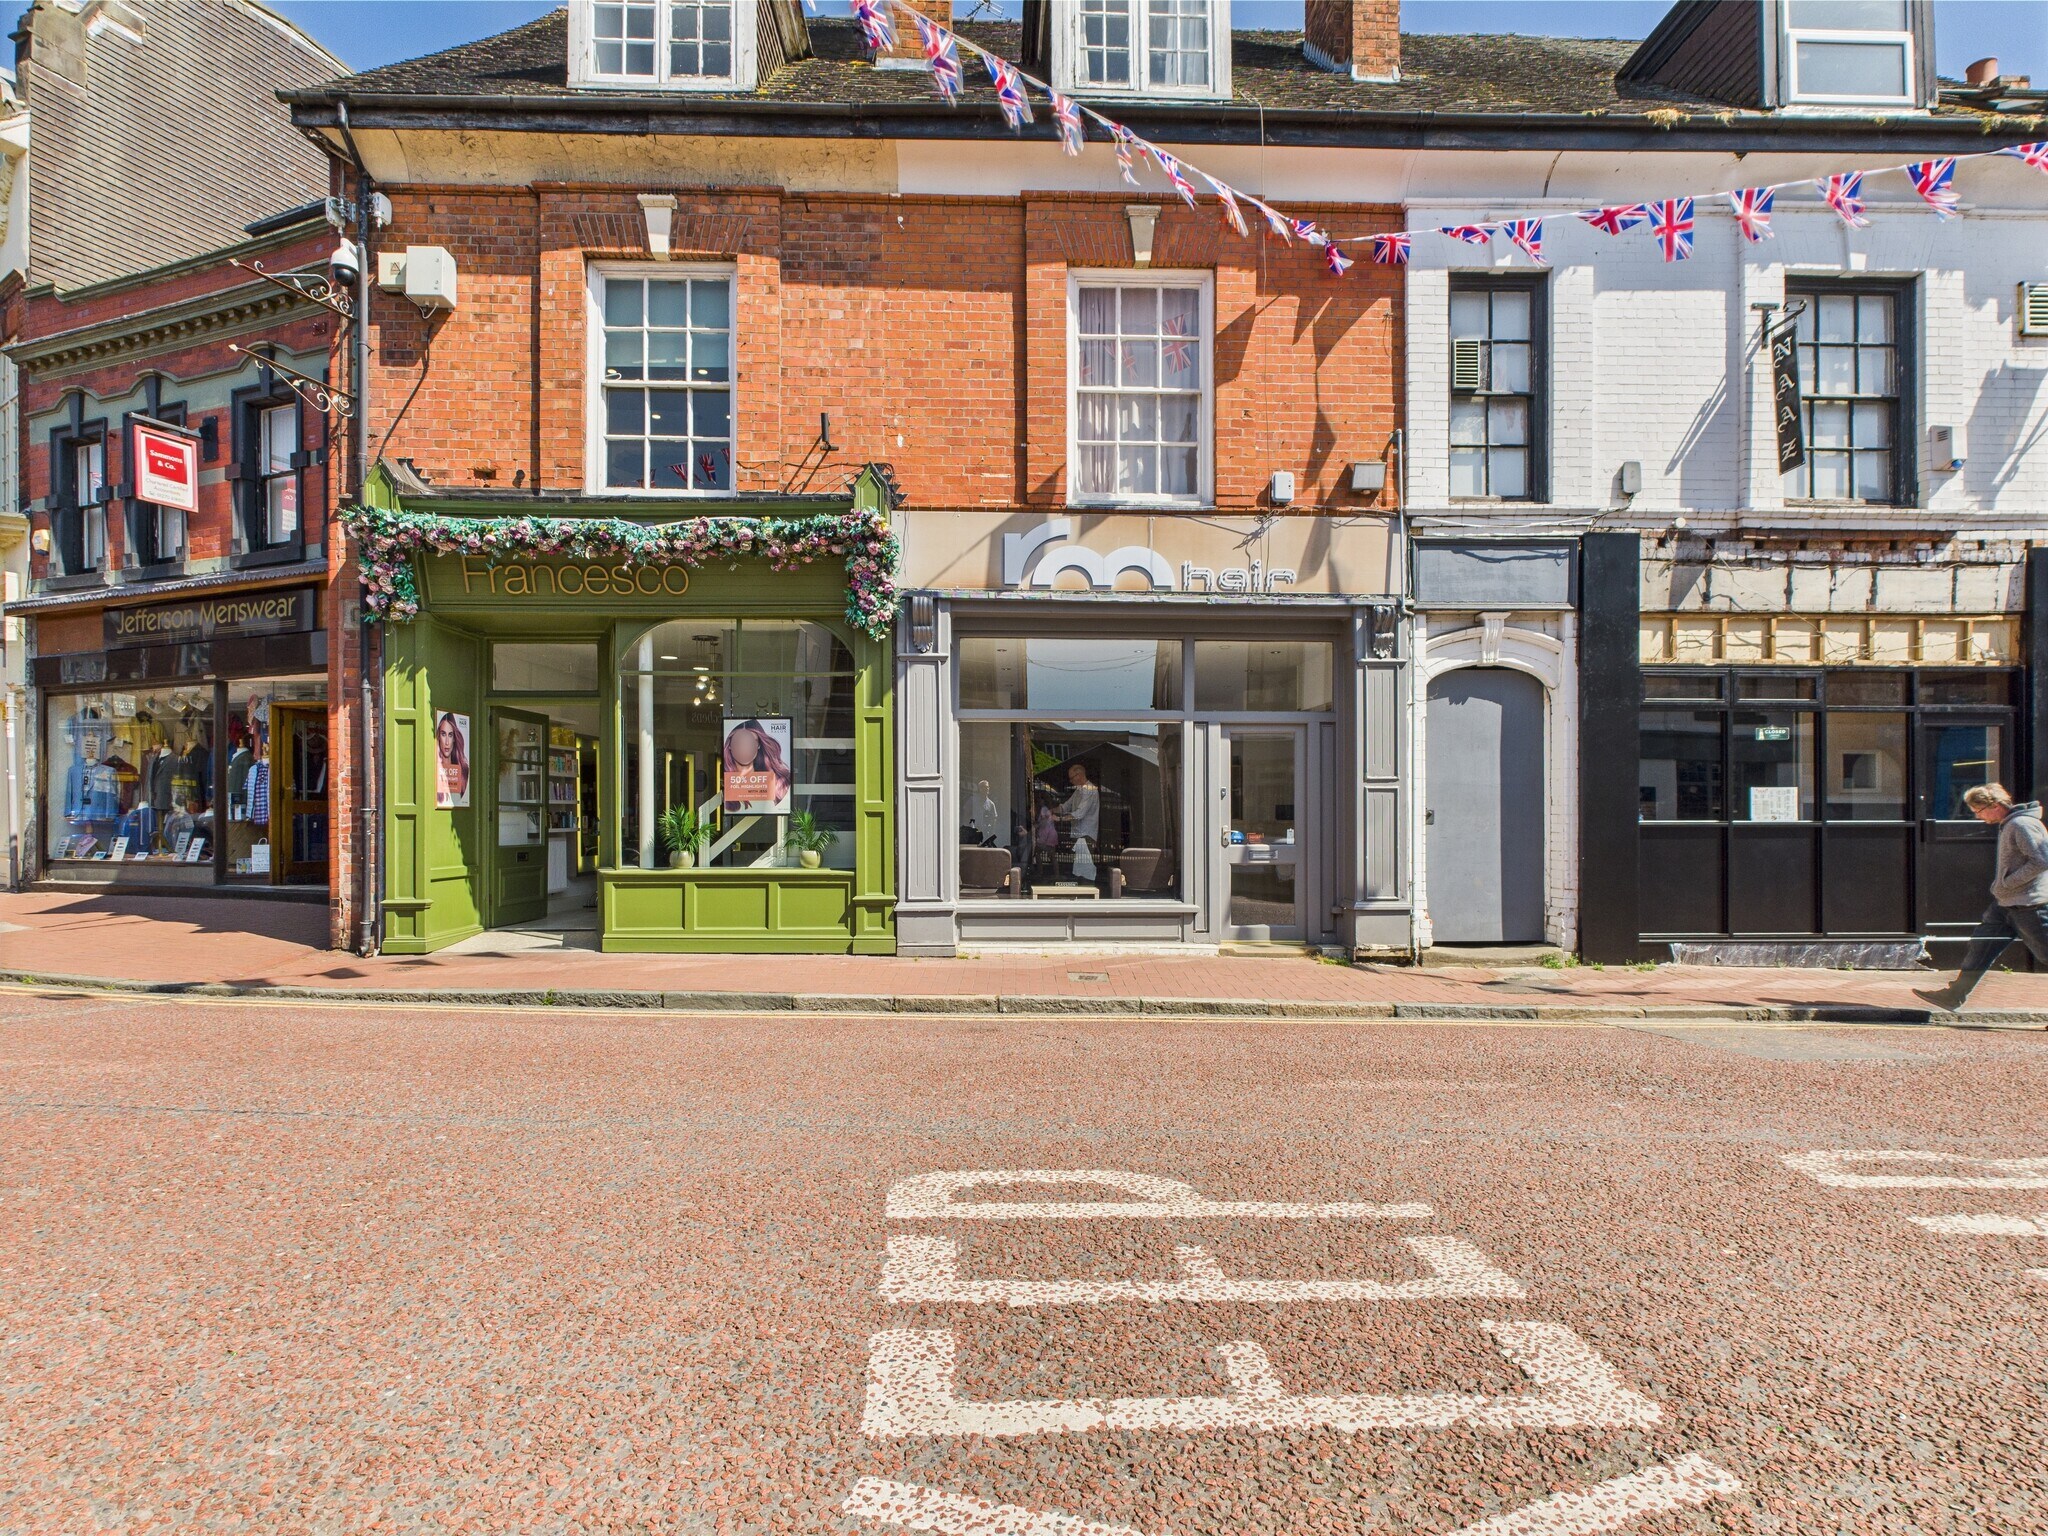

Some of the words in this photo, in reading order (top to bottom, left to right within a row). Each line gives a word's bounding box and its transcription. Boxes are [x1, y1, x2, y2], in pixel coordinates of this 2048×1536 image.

[1773, 335, 1798, 463] NAAZ
[149, 449, 183, 464] Sammons
[164, 462, 176, 470] Co.
[461, 554, 689, 595] Francesco
[1182, 559, 1297, 591] hair
[116, 608, 193, 634] Jefferson
[199, 596, 297, 627] Menswear
[449, 768, 458, 776] OFF
[730, 775, 747, 784] 50%
[750, 775, 767, 783] OFF
